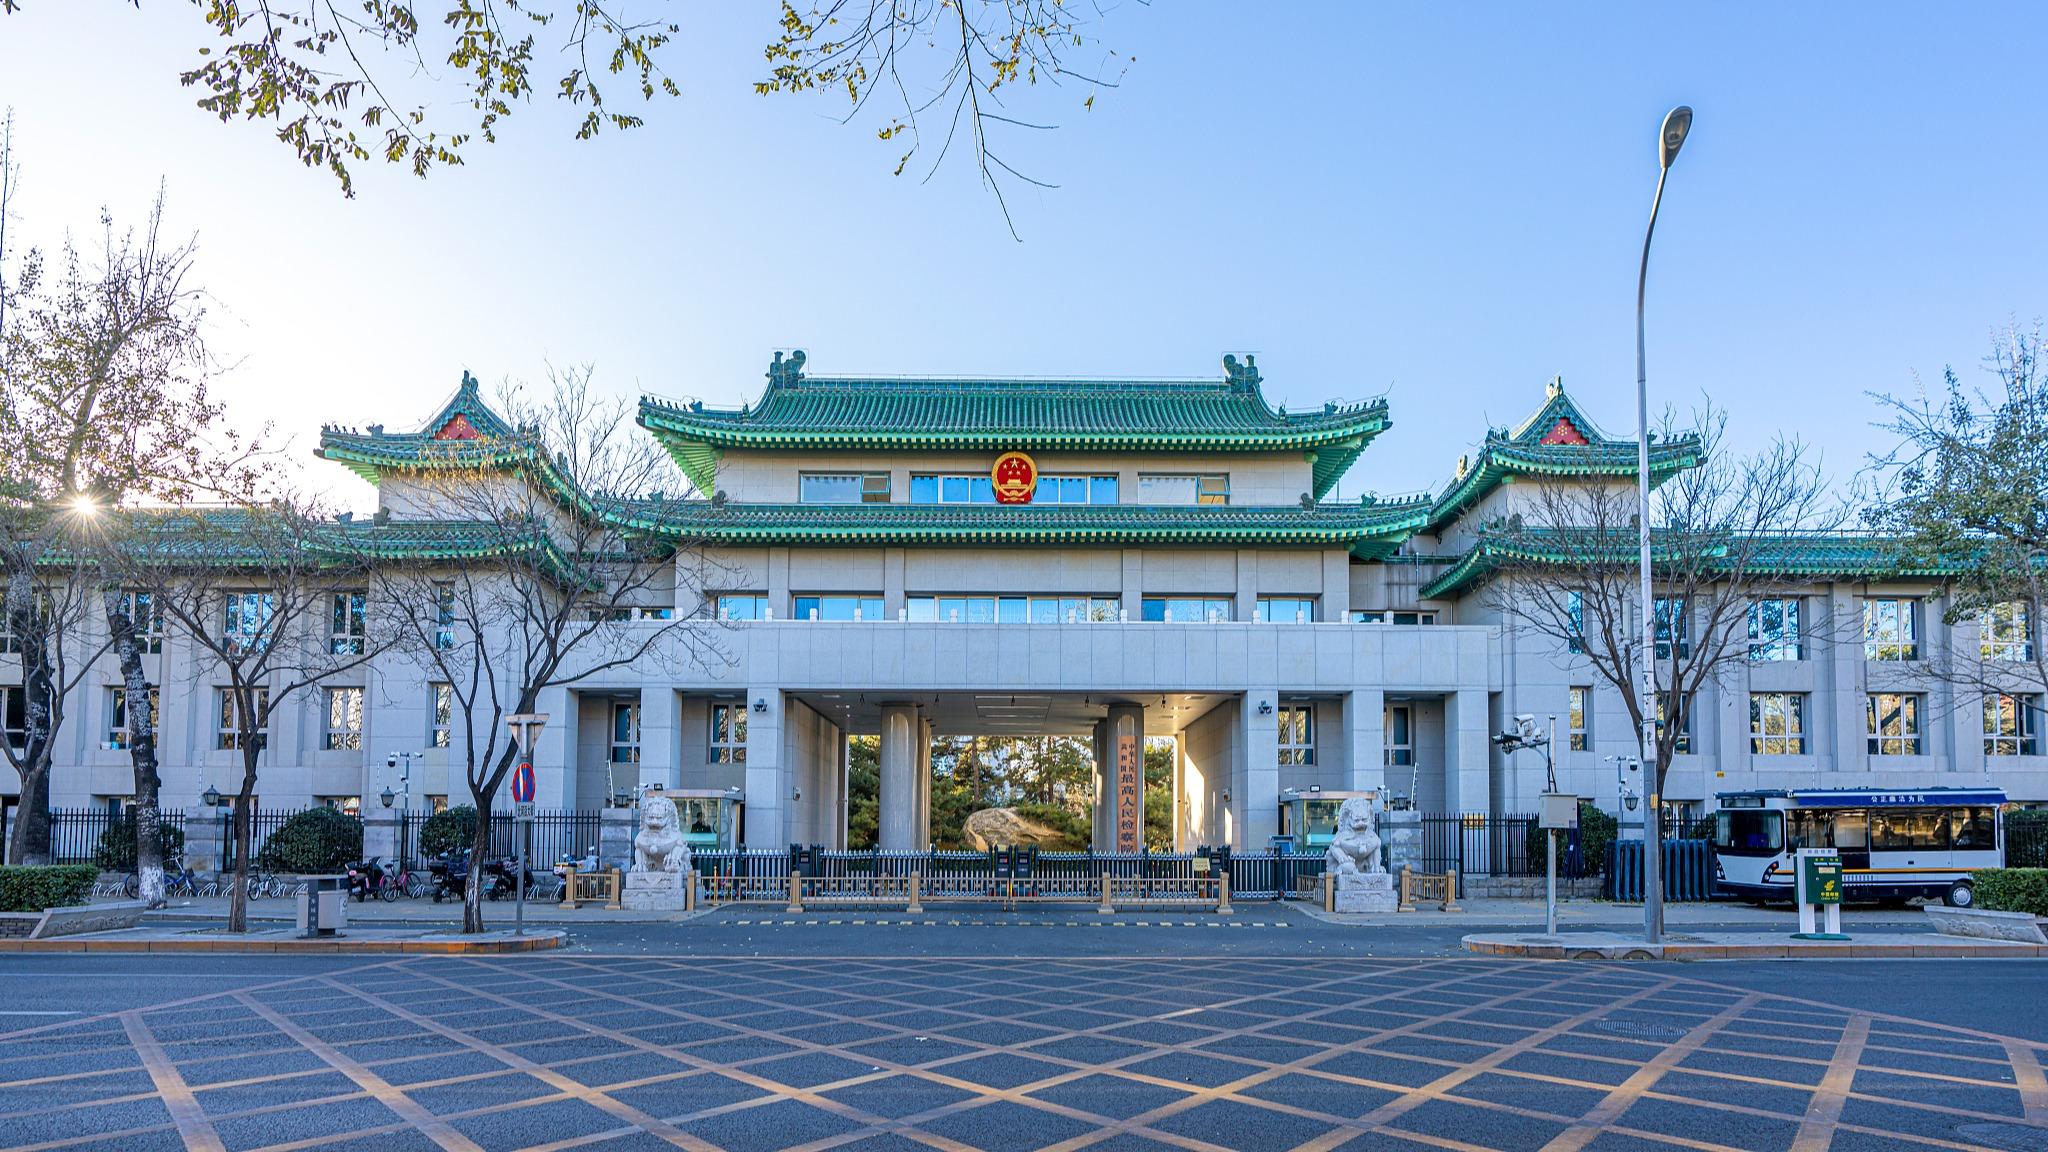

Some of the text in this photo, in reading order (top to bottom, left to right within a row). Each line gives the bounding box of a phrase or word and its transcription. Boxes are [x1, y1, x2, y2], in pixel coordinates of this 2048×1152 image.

[1120, 774, 1135, 854] 最高人民检察院
